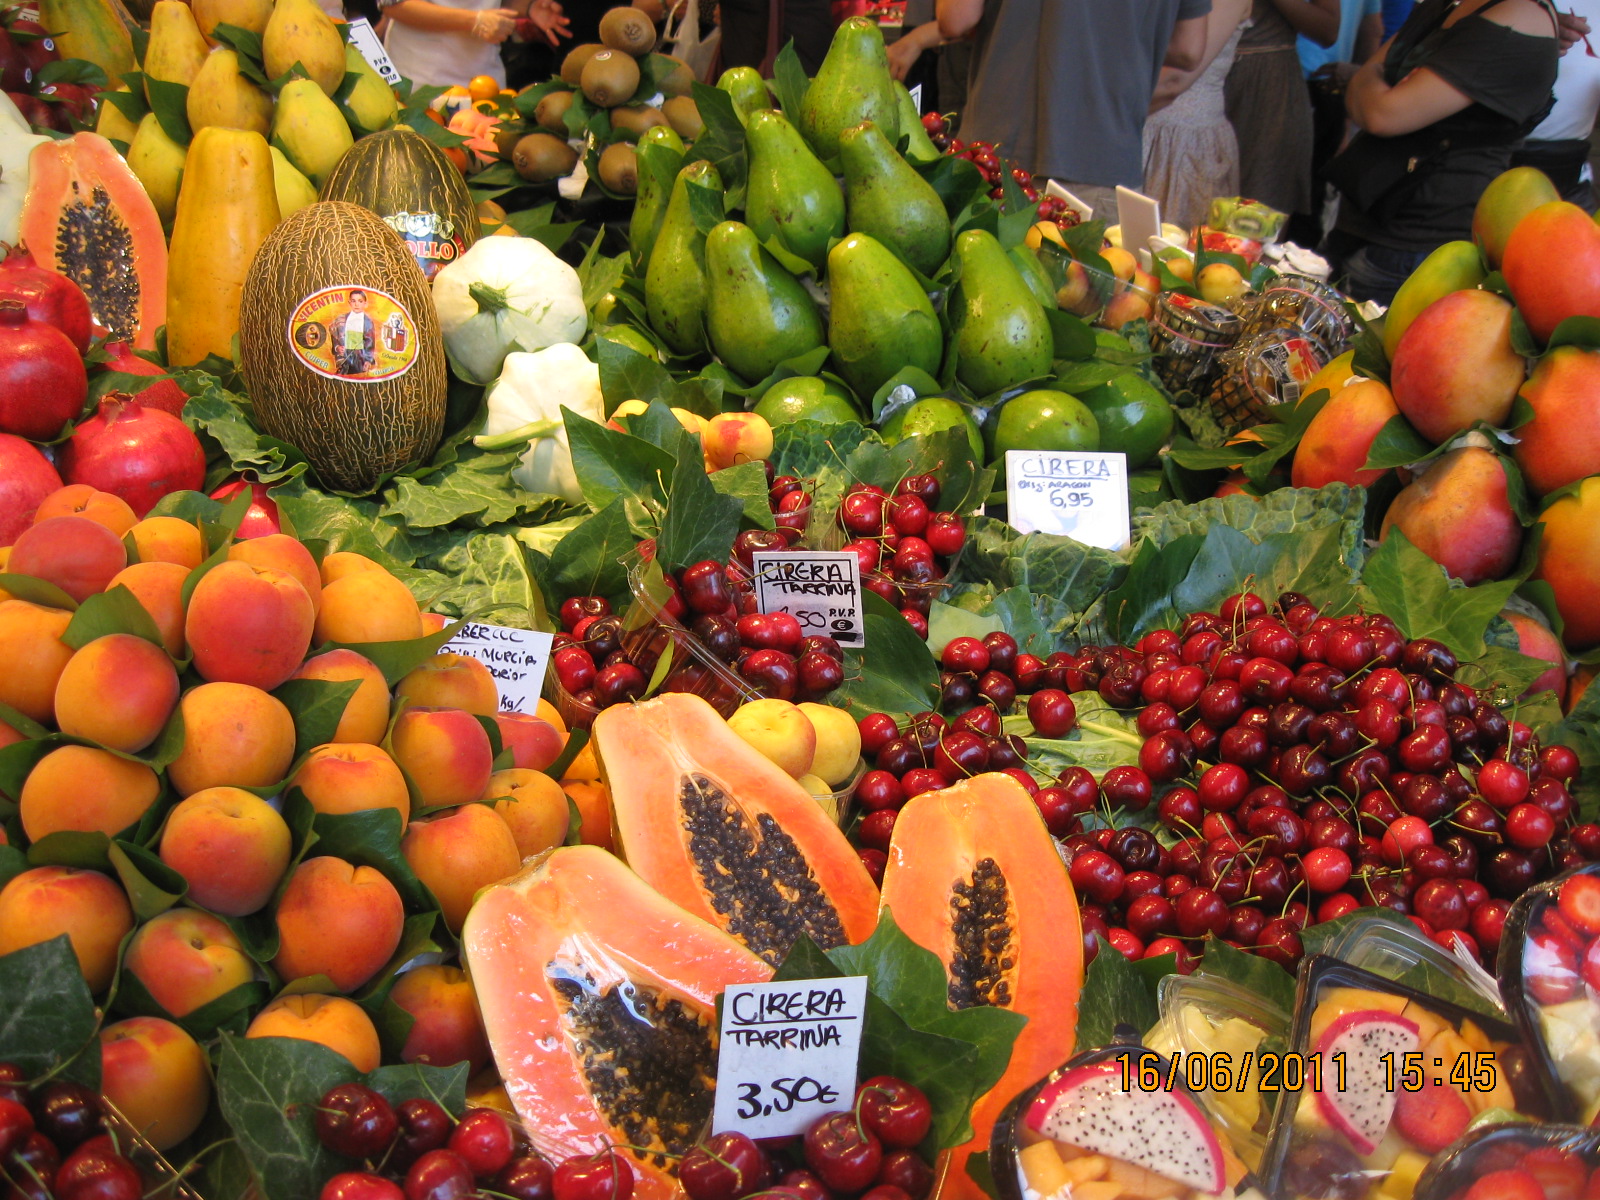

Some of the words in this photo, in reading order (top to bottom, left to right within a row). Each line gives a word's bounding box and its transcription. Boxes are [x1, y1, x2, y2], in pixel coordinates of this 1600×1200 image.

[297, 292, 345, 323] VICENTIN
[1047, 481, 1092, 489] ARAGON
[1049, 489, 1094, 508] 6,95
[761, 562, 843, 581] CIRERA
[772, 582, 857, 597] TARRINA
[828, 608, 856, 618] P.V.P.
[732, 988, 847, 1023] CIRERA
[725, 1024, 842, 1051] TARRINA
